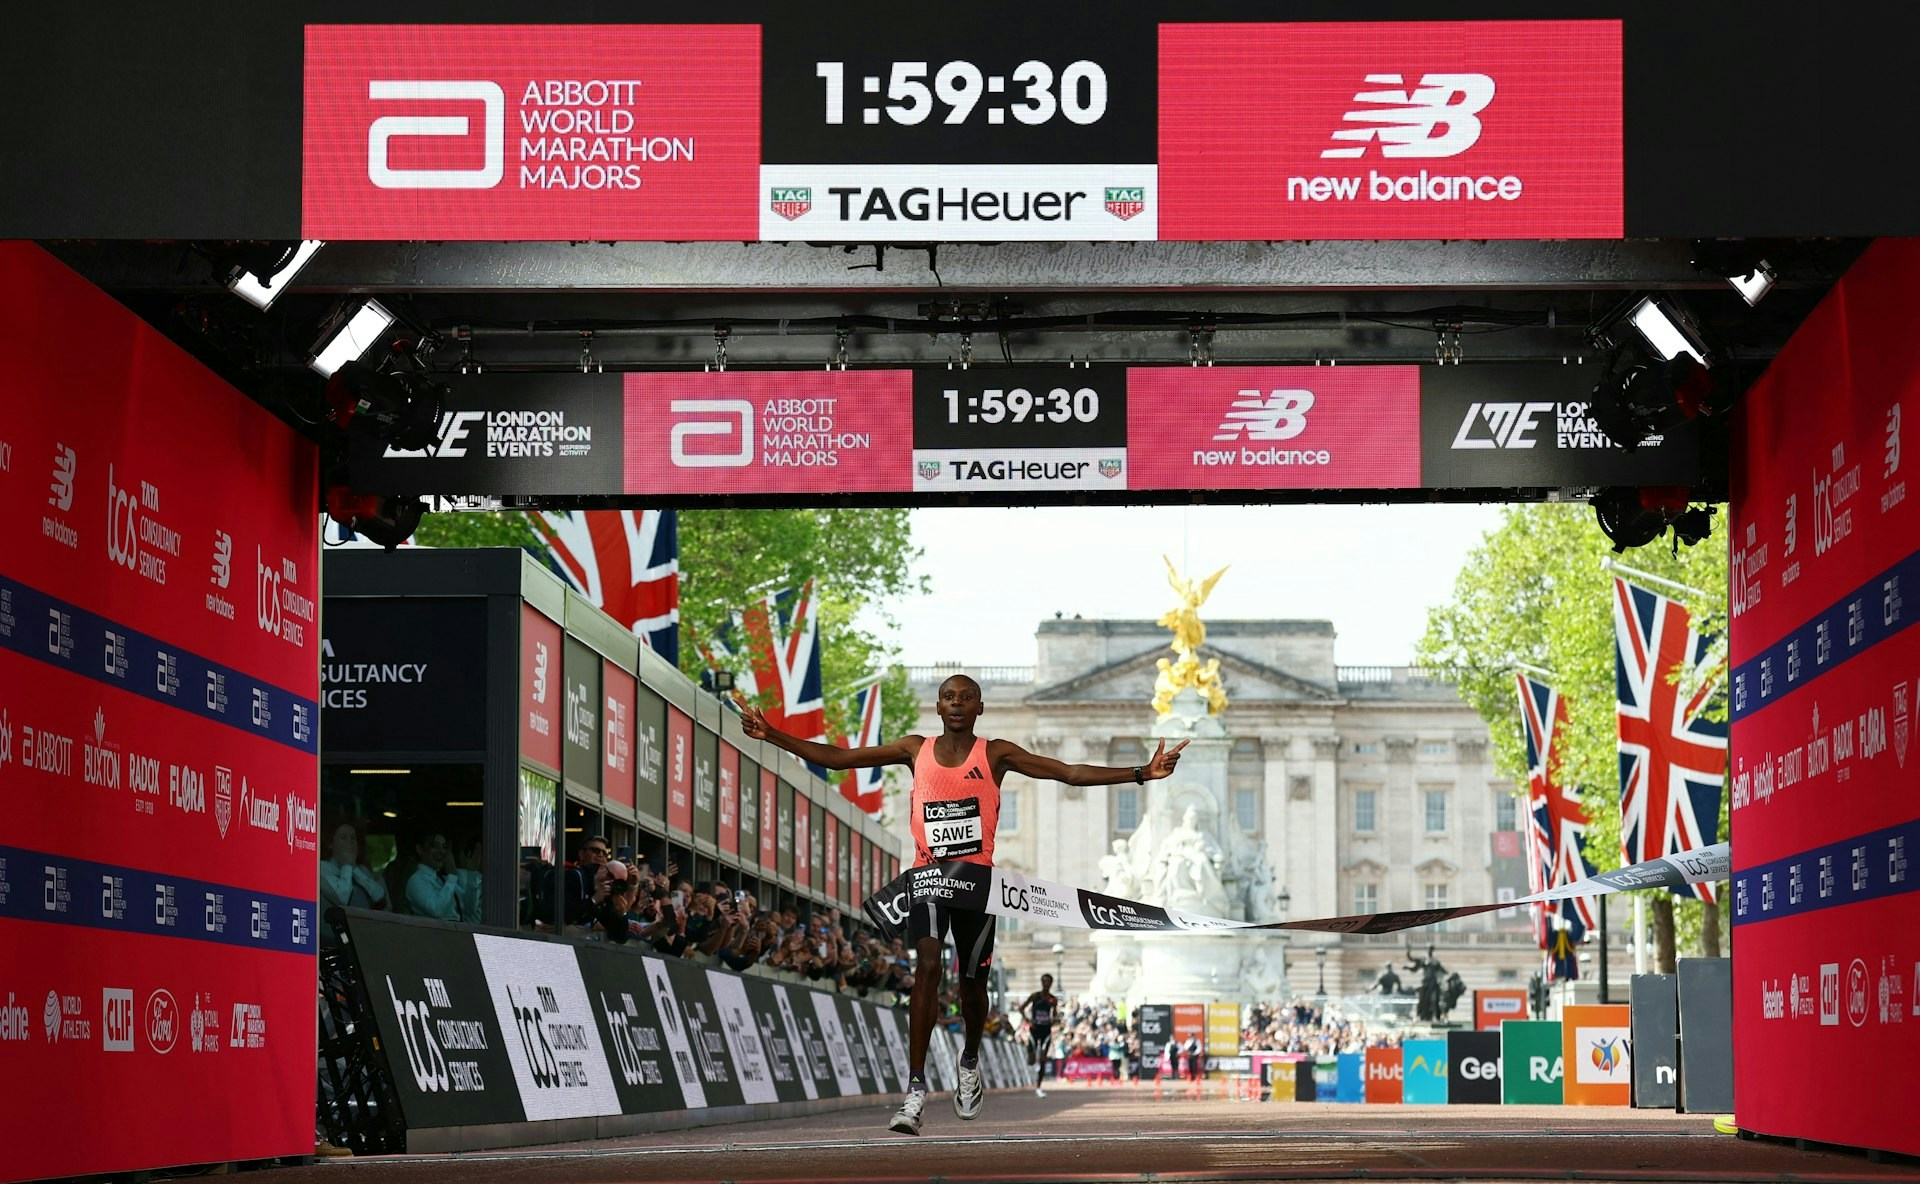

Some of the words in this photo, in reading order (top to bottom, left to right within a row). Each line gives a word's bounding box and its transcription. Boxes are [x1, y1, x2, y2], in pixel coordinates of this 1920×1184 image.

[521, 80, 641, 106] ABBOTT
[817, 60, 1107, 125] 1:59:30
[520, 109, 634, 134] WORLD
[520, 137, 694, 161] MARATHON
[520, 165, 641, 190] MAJORS
[1288, 176, 1361, 201] new
[1369, 170, 1522, 201] balance
[776, 190, 807, 200] TAG
[1109, 190, 1139, 200] TAG
[487, 411, 564, 427] LONDON
[763, 399, 838, 415] ABBOTT
[943, 388, 1098, 424] 1:59:30
[487, 427, 591, 443] MARATHON
[763, 417, 833, 432] WORLD
[487, 442, 554, 458] EVENTS
[763, 433, 870, 449] MARATHON
[763, 450, 838, 467] MAJORS
[1193, 451, 1237, 465] new
[1241, 447, 1330, 465] balance
[141, 480, 159, 512] TATA
[107, 463, 137, 570] tcs
[42, 516, 57, 538] new
[55, 520, 78, 549] balance
[140, 515, 181, 557] CONSULTANCY
[139, 550, 166, 585] SERVICES
[283, 557, 297, 584] TATA
[257, 544, 281, 637] tcs
[283, 587, 314, 623] CONSULTANCY
[283, 618, 304, 647] SERVICES
[1859, 706, 1887, 760] FLORA
[35, 730, 73, 776] ABBOTT
[85, 743, 120, 790] BUXTON
[129, 752, 160, 796] RADOX
[216, 771, 230, 795] TAG
[170, 765, 206, 813] FLORA
[250, 788, 280, 833] Lucozade
[926, 805, 945, 819] tcs
[932, 825, 973, 842] SAWE
[914, 868, 942, 880] TATA
[1602, 873, 1642, 887] tcs
[1675, 857, 1709, 876] tcs
[913, 877, 975, 893] CONSULTANCY
[913, 888, 954, 899] SERVICES
[1001, 878, 1029, 912] tcs
[1030, 885, 1047, 896] TATA
[1030, 896, 1070, 912] CONSULTANCY
[1032, 907, 1059, 919] SERVICES
[1087, 898, 1125, 927] tcs
[1117, 905, 1137, 915] TATA
[423, 978, 451, 1008] TATA
[537, 986, 559, 1013] TATA
[1762, 979, 1784, 1019] Vaseline
[1850, 968, 1866, 1014] Ford
[62, 996, 81, 1014] WORLD
[62, 1019, 91, 1039] ATHLETICS
[106, 997, 132, 1042] CLIF
[151, 997, 172, 1042] Ford
[386, 975, 449, 1092] tcs
[437, 1020, 488, 1050] CONSULTANCY
[507, 984, 560, 1088] tcs
[549, 1025, 588, 1050] CONSULTANCY
[600, 991, 644, 1085] tcs
[449, 1062, 484, 1091] SERVICES
[558, 1061, 588, 1087] SERVICES
